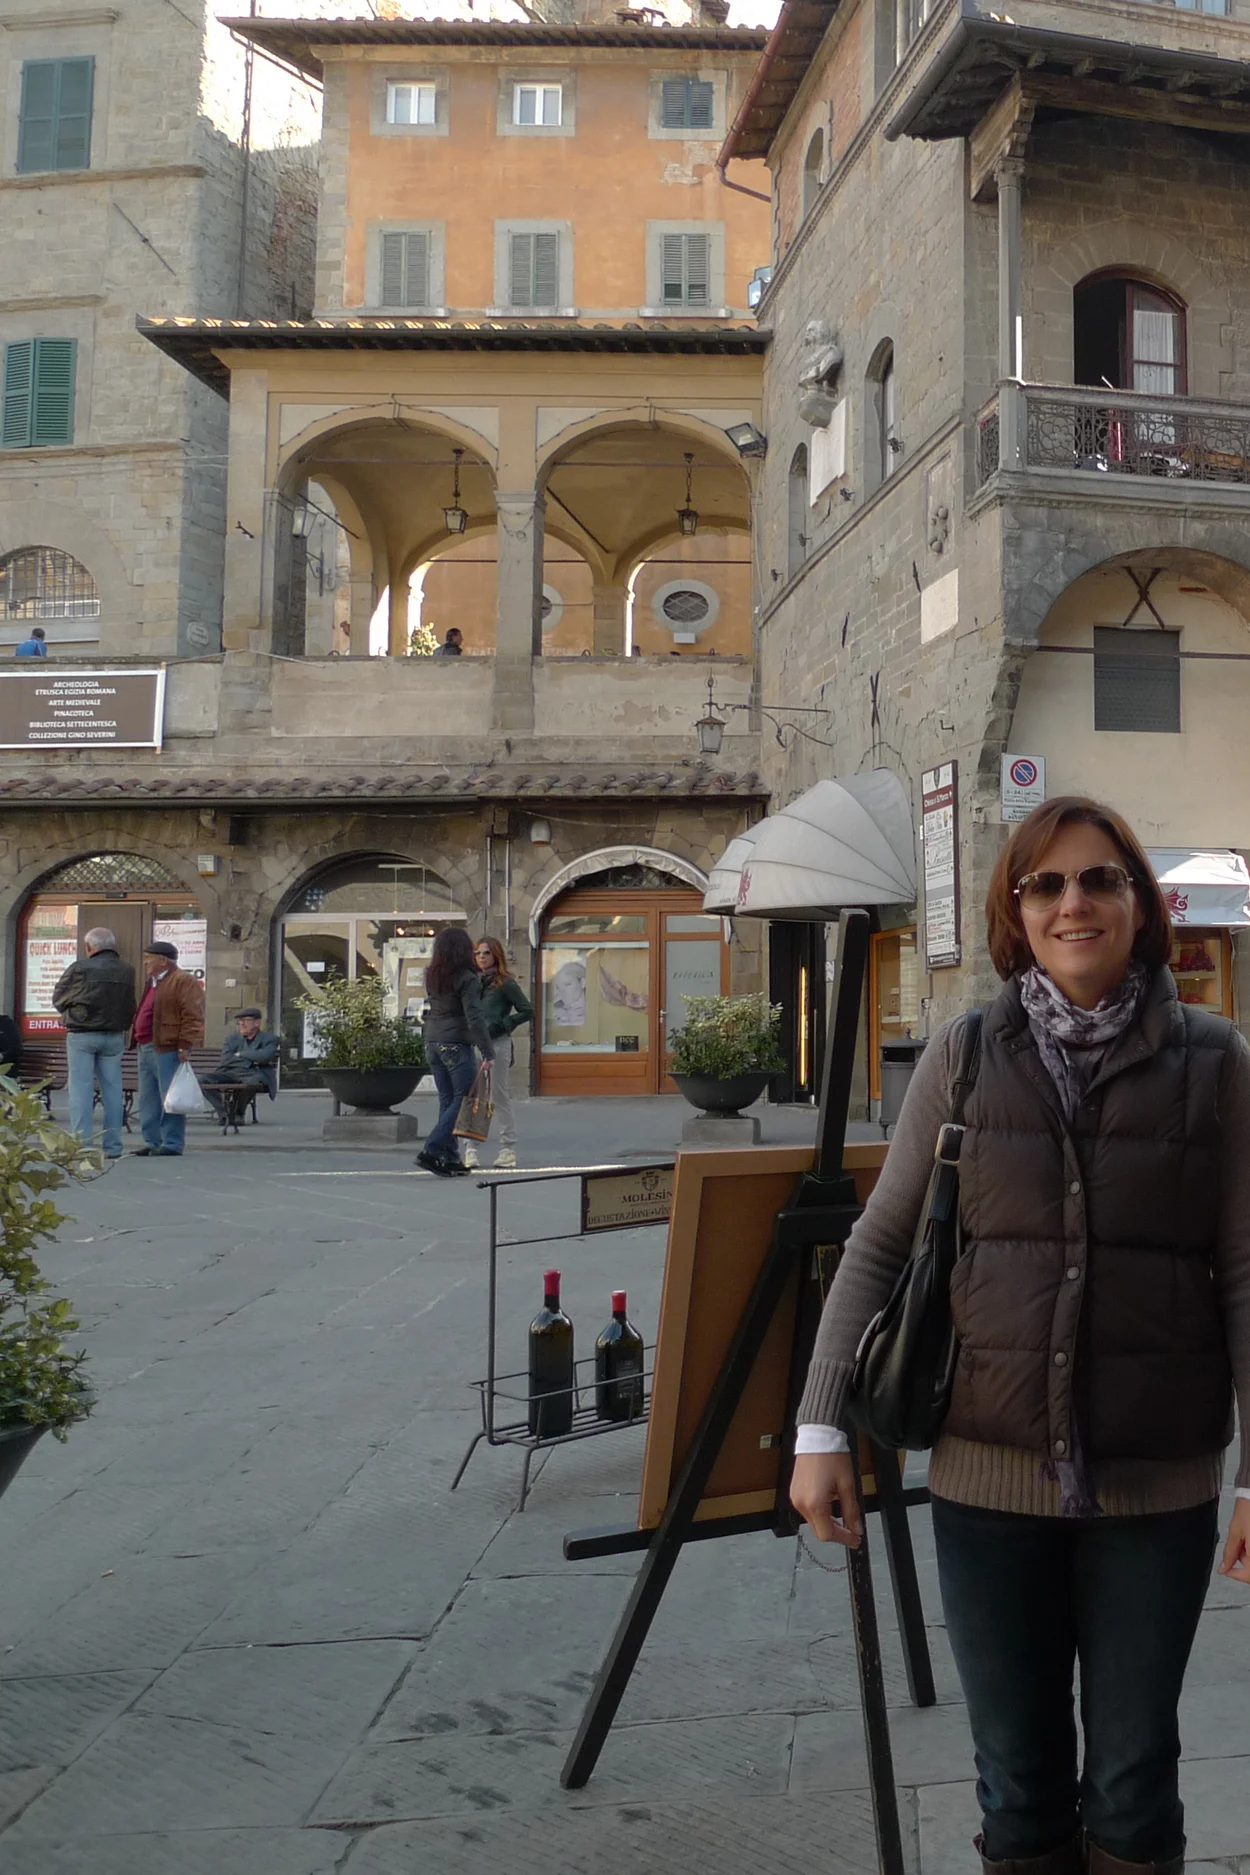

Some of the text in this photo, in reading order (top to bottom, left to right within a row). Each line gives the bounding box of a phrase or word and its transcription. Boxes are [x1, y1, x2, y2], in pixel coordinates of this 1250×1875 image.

[35, 688, 64, 696] ETRUSCA
[66, 720, 117, 728] SETTECENTESCA
[30, 942, 51, 957] QUICK
[28, 1020, 61, 1030] ENTRA
